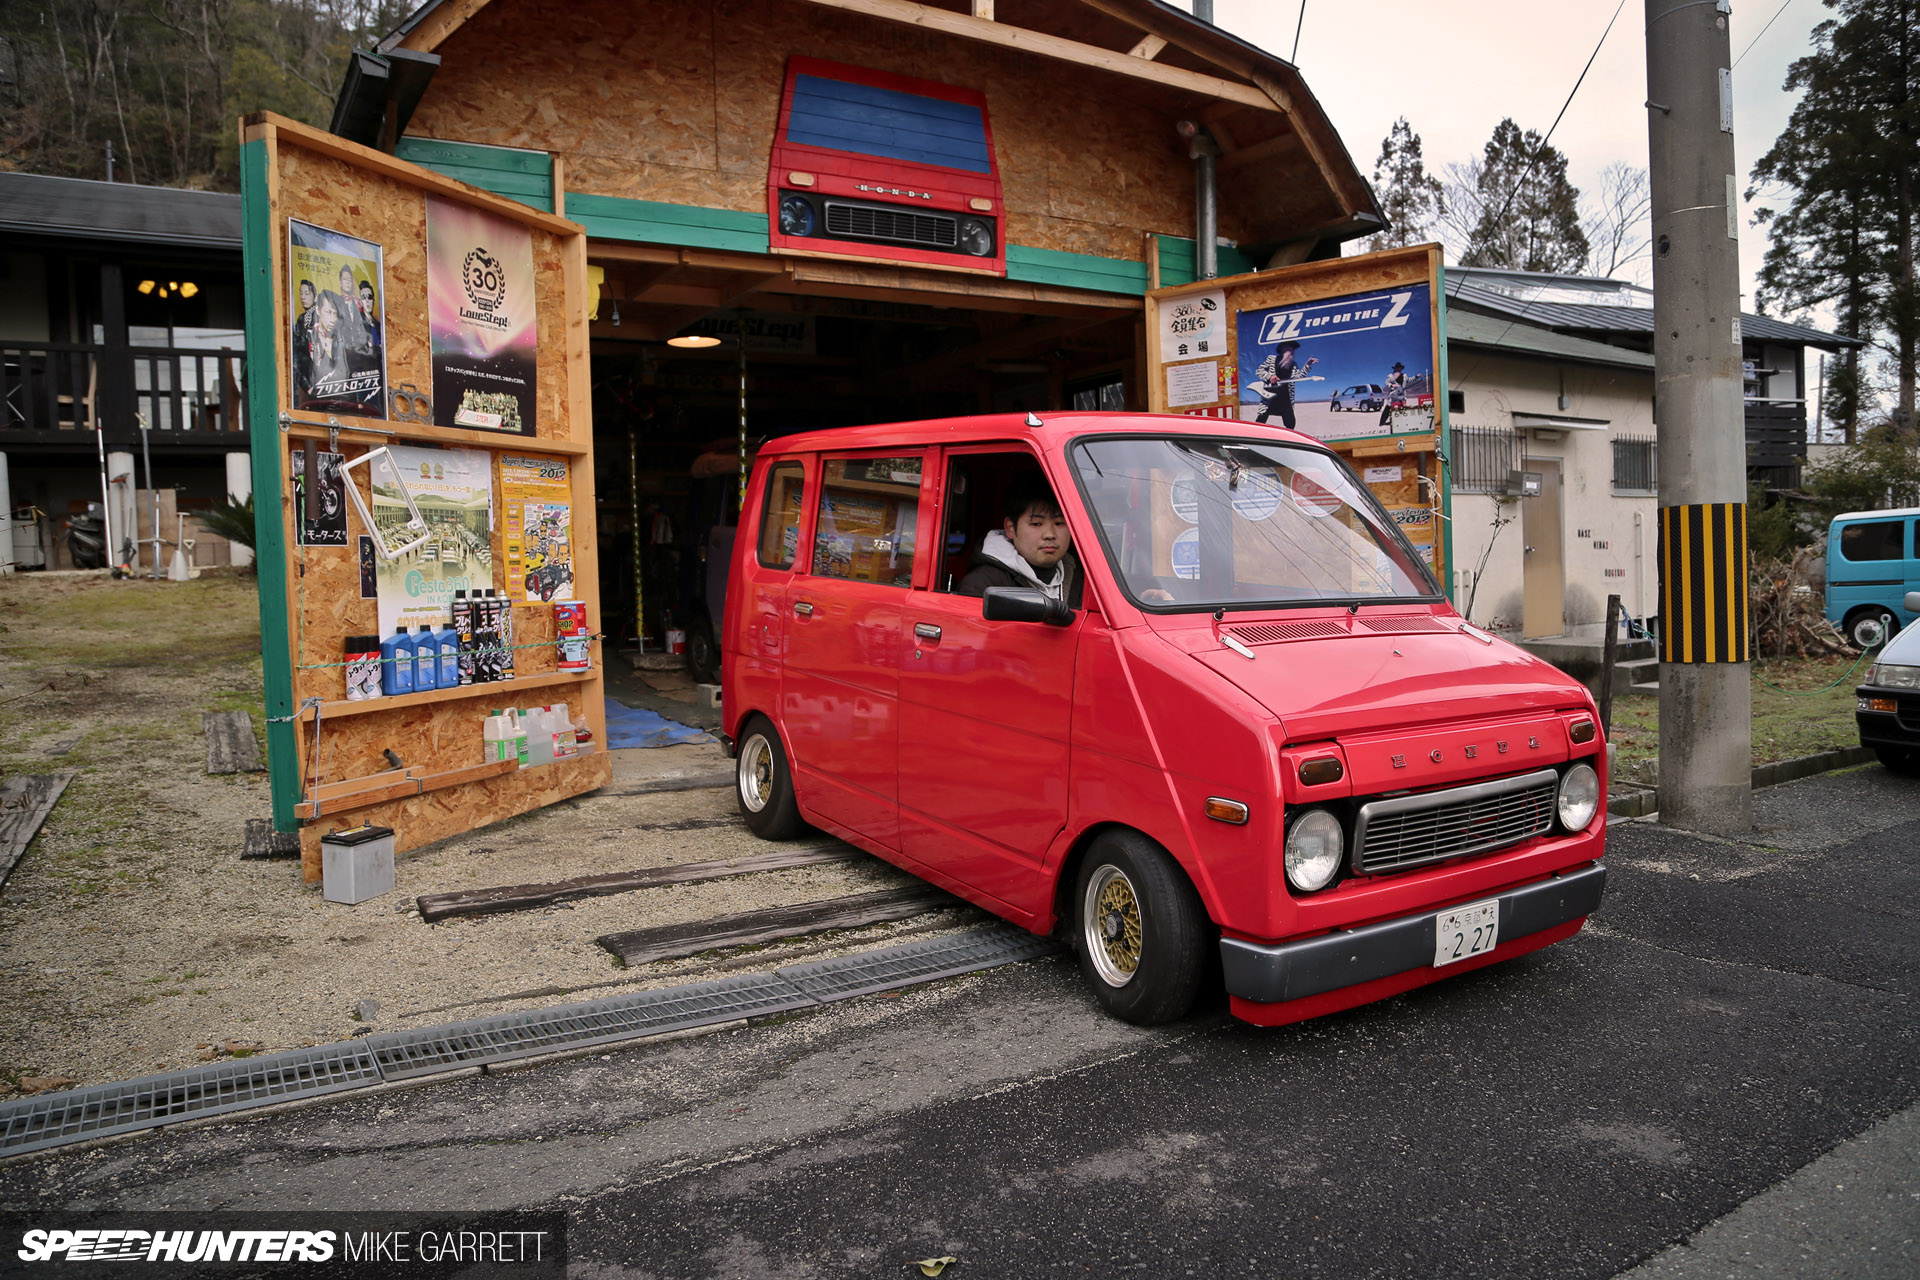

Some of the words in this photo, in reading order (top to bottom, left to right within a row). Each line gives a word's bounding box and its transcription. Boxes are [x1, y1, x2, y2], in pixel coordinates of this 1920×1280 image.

[860, 184, 931, 199] HONDA
[472, 267, 497, 292] 30
[1171, 316, 1206, 333] 全員集合
[1266, 311, 1304, 341] ZZ
[1305, 316, 1330, 328] TOP
[1333, 313, 1352, 324] ON
[1354, 309, 1380, 321] THE
[1379, 292, 1412, 328] Z
[540, 468, 566, 478] 2012
[1396, 514, 1431, 525] 2012
[307, 529, 342, 541] モータース
[1577, 529, 1591, 538] BASE
[1391, 736, 1541, 768] HONDA
[1442, 914, 1461, 932] 66
